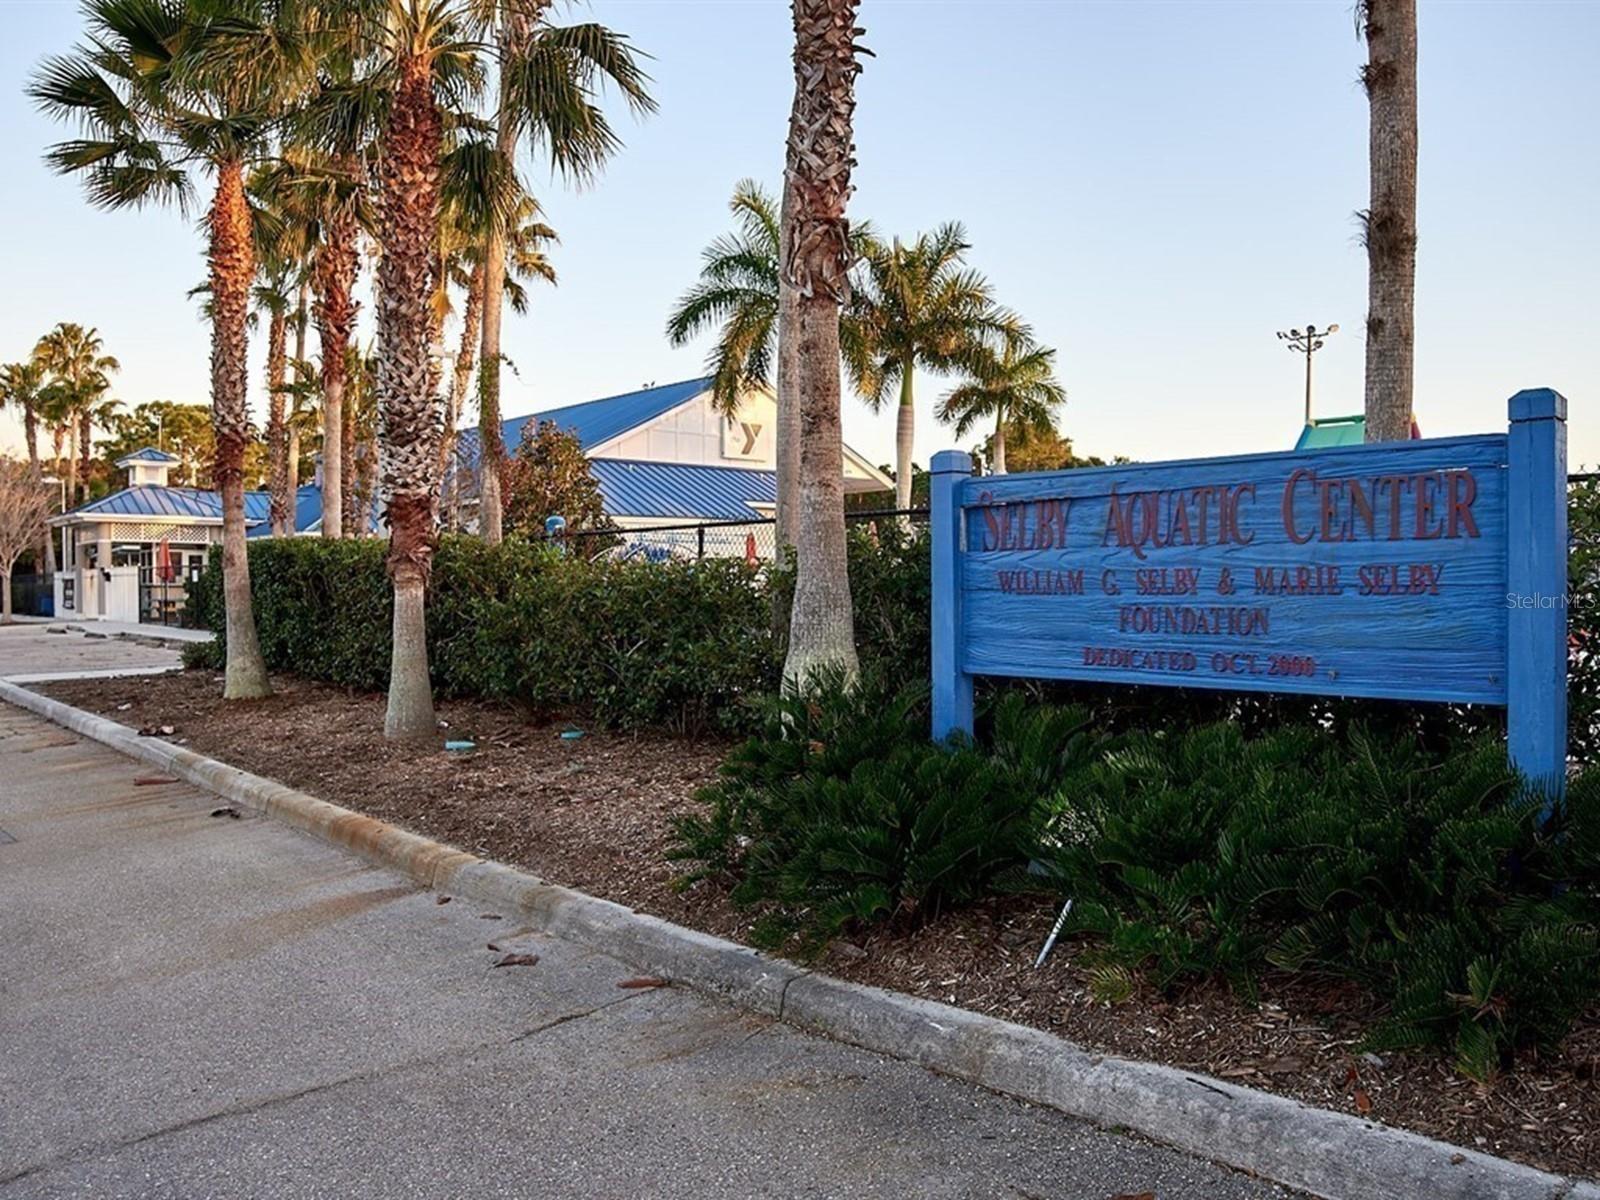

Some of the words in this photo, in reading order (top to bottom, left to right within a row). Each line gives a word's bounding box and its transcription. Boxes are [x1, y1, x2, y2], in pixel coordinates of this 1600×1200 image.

[980, 491, 1070, 552] SELBY
[1101, 482, 1257, 560] AQUATIC
[1282, 467, 1481, 545] CENTER
[997, 568, 1085, 596] WILLIAM
[1136, 567, 1201, 596] SELBY
[1217, 566, 1237, 596] &
[1254, 566, 1342, 596] MARIE
[1358, 563, 1444, 596] SELBY
[1118, 606, 1270, 636] FOUNDATION
[1083, 647, 1197, 672] DEDICATED
[1267, 655, 1316, 677] 2000
